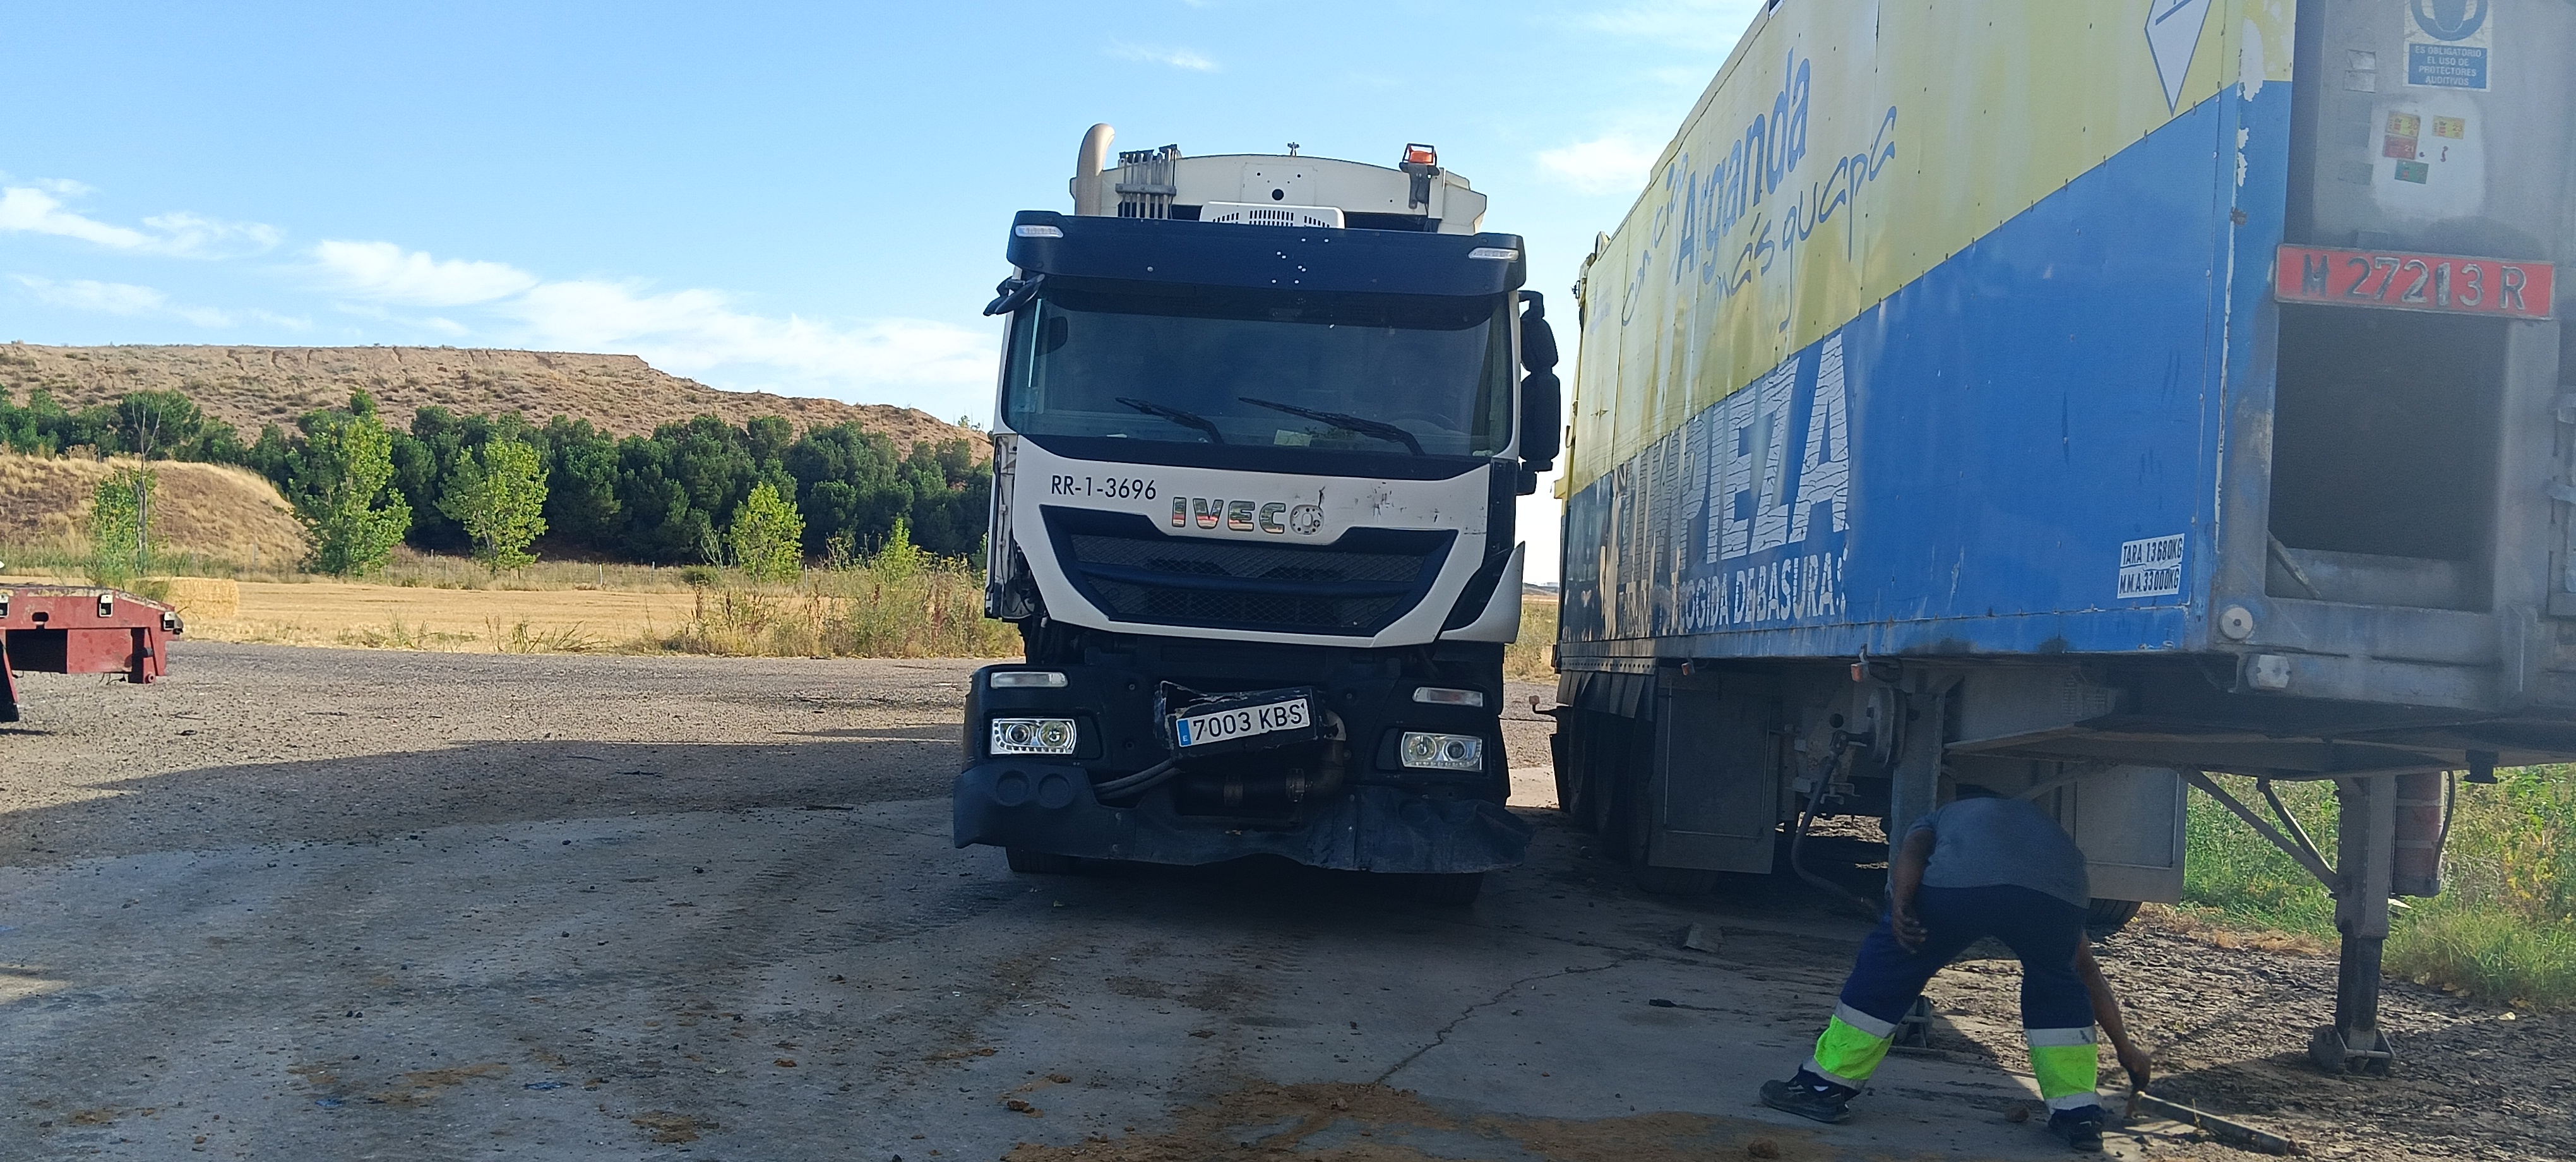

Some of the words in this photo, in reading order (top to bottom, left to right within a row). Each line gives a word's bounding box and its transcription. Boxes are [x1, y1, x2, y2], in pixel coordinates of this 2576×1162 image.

[2416, 45, 2426, 54] ES
[2428, 47, 2481, 57] OBLIGATORIO
[2427, 56, 2435, 64] EL
[2439, 57, 2456, 66] USO
[2458, 58, 2469, 66] DE
[2419, 66, 2476, 76] PROTECTORES
[2425, 76, 2469, 86] AUDITIVOS
[1675, 47, 1810, 286] Arganda
[1779, 105, 1897, 333] guapa
[2345, 256, 2485, 308] 27213
[2499, 265, 2527, 310] R
[1051, 475, 1157, 500] RR-1-3696
[2123, 544, 2142, 565] TARA
[1193, 712, 1251, 741] 7003
[1258, 704, 1303, 729] KBS
